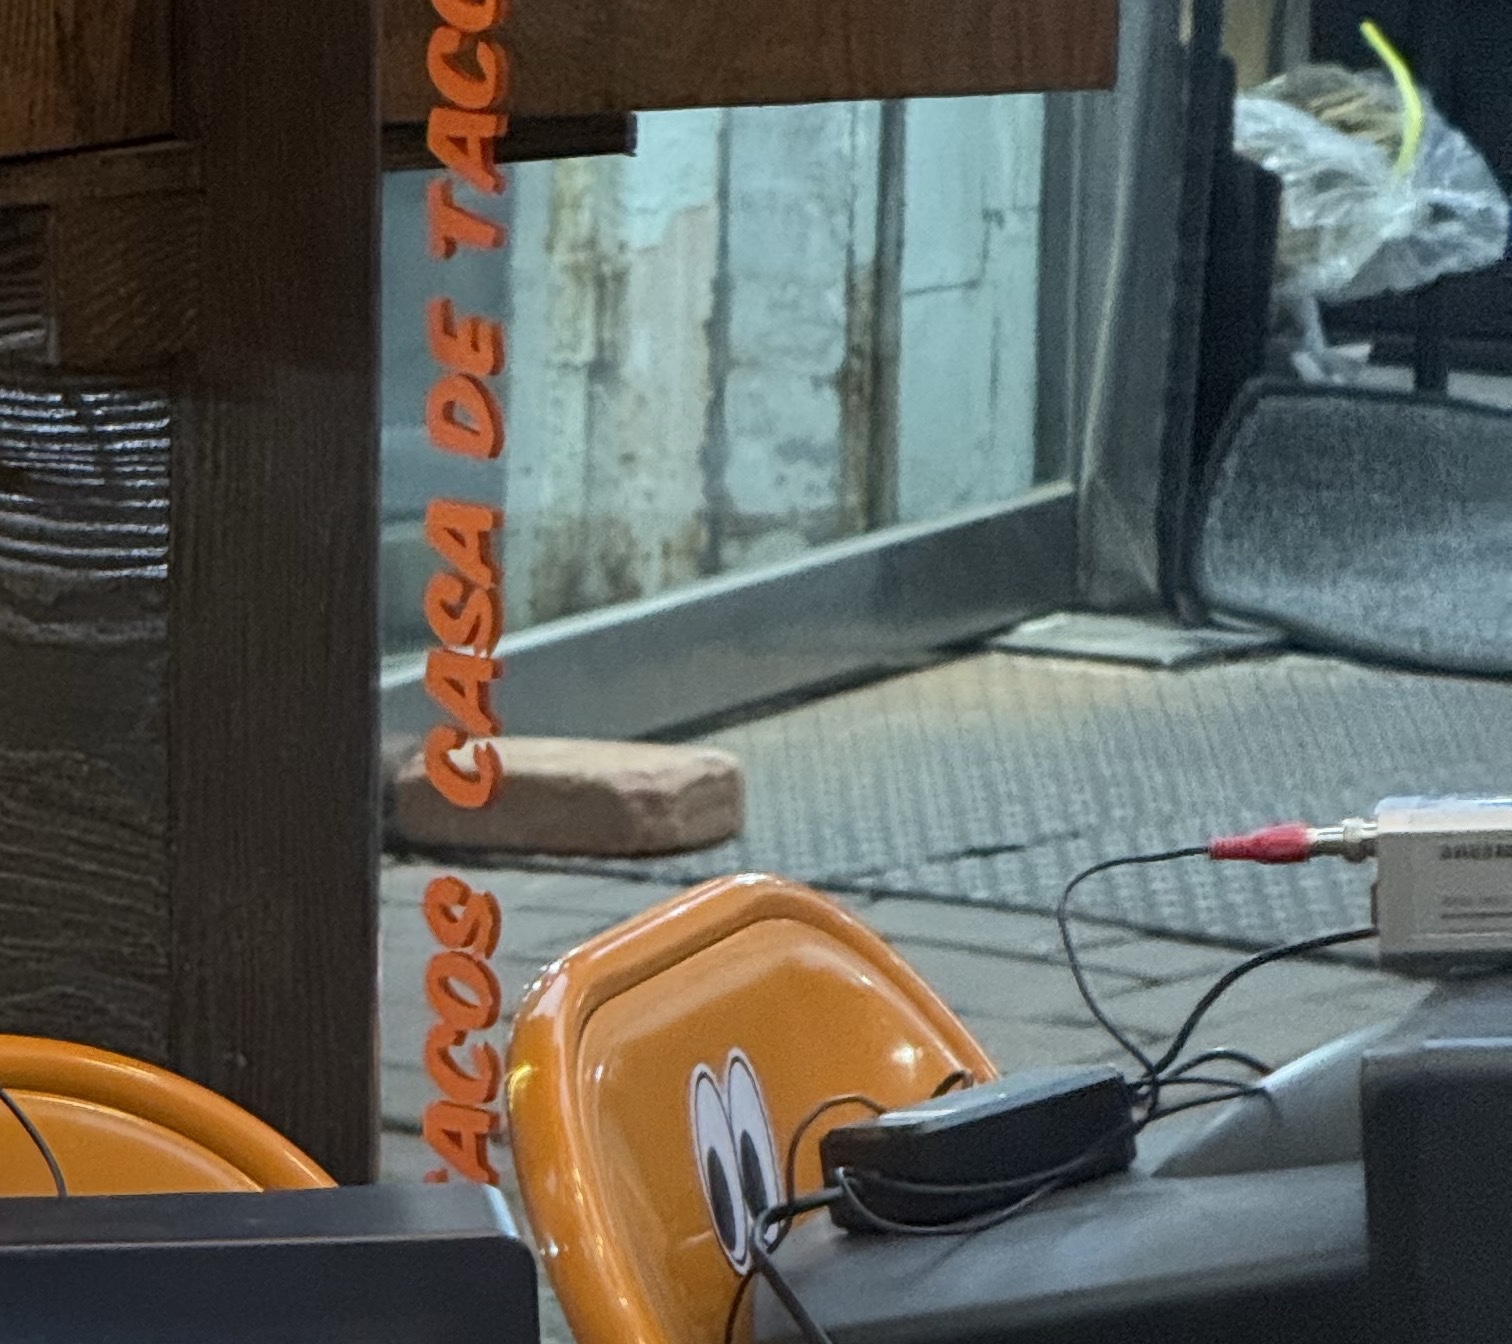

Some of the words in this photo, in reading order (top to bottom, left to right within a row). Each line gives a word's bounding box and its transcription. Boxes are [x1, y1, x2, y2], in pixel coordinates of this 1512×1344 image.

[426, 297, 506, 459] DE
[423, 499, 505, 809] CASA
[422, 875, 502, 1185] ACOS
